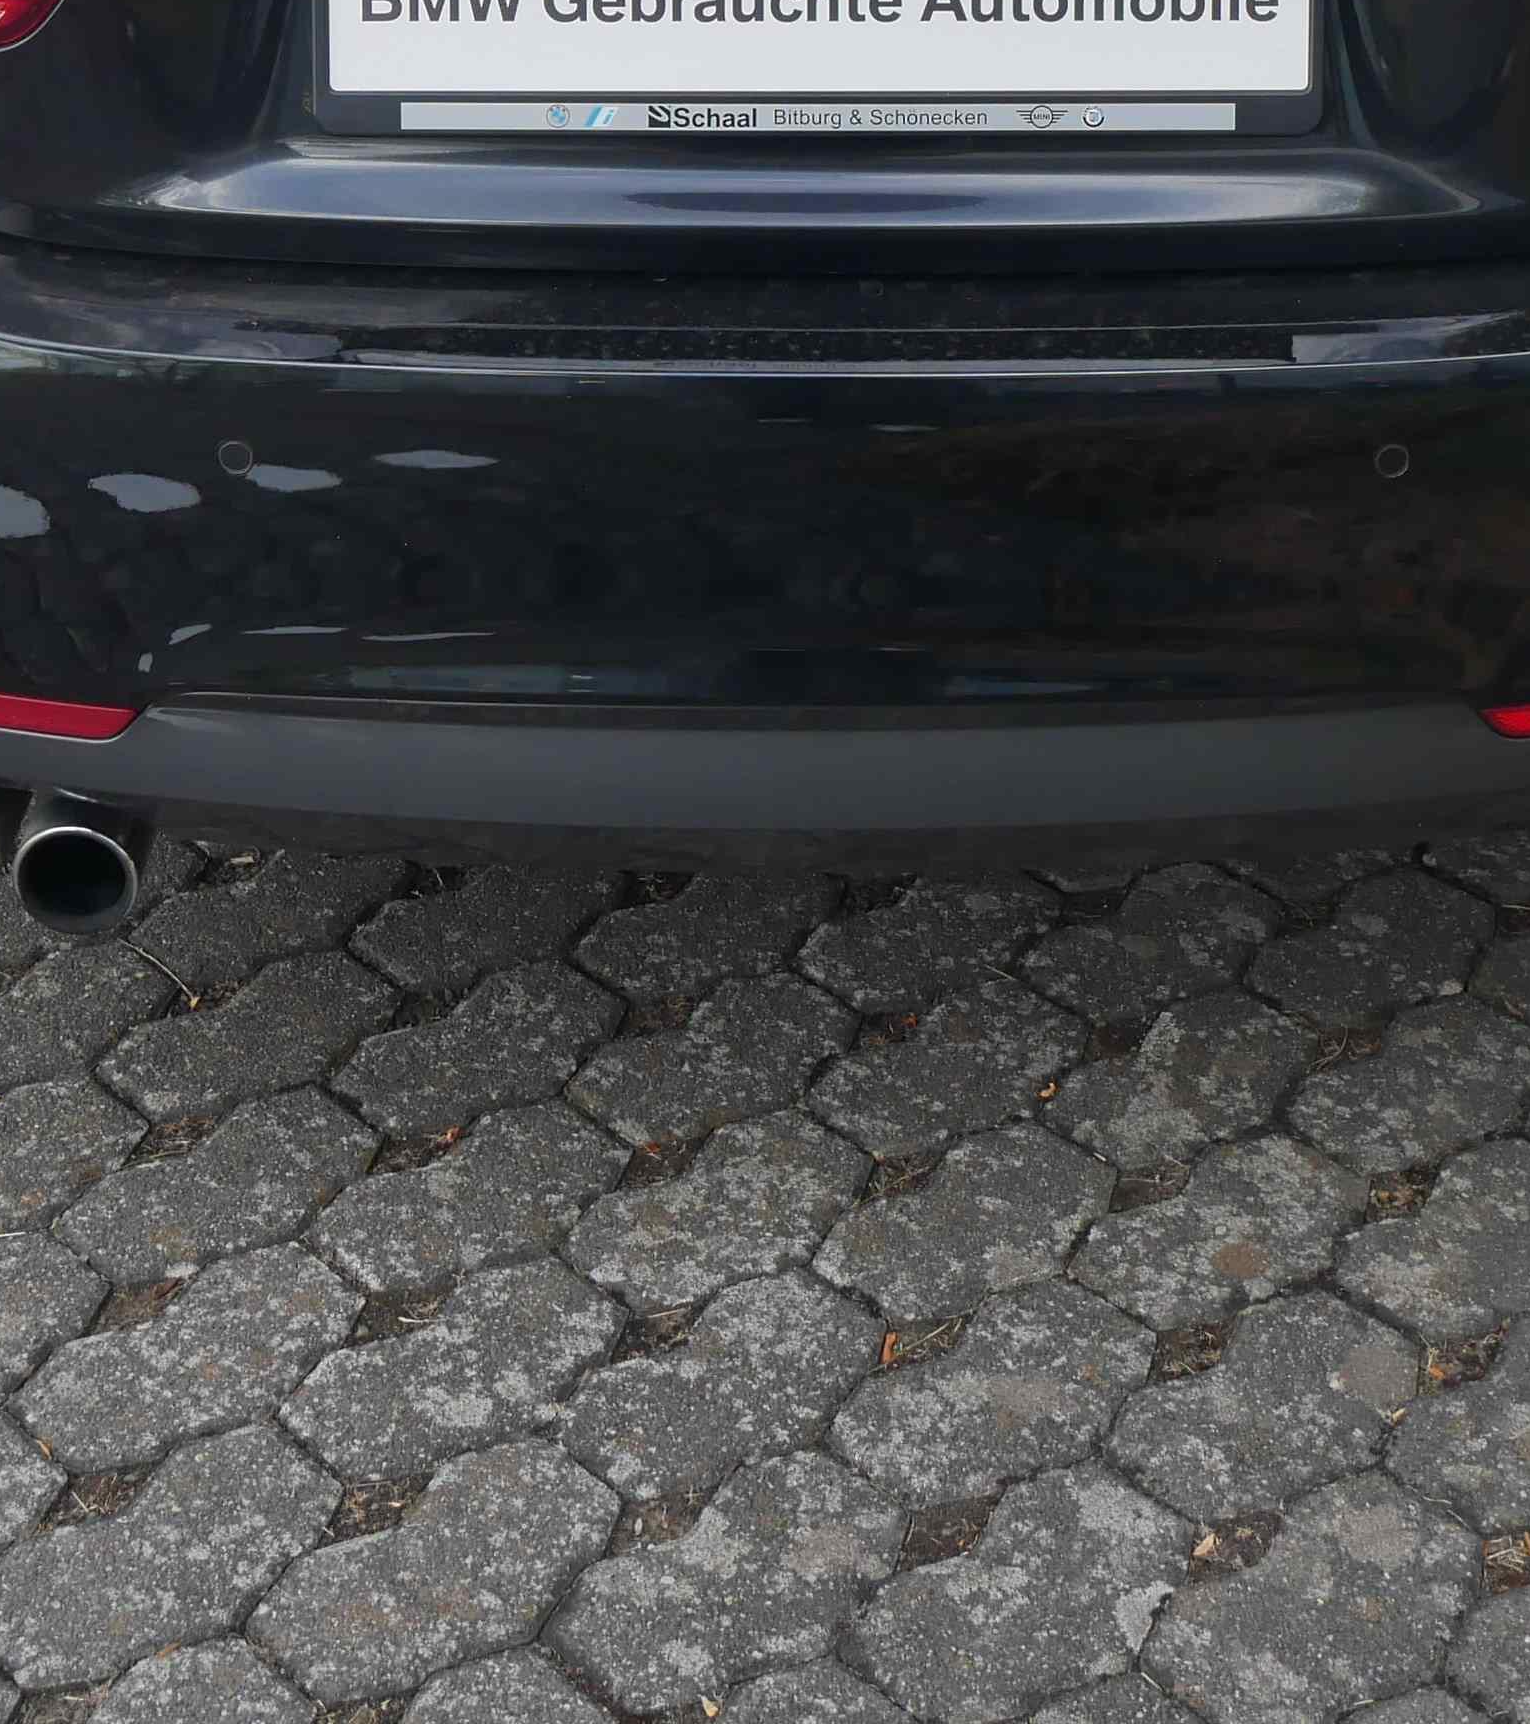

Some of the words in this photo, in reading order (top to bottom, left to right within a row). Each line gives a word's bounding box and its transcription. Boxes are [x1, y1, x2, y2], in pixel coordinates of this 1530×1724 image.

[672, 107, 758, 129] Schaal
[773, 108, 843, 129] Bitburg
[848, 108, 863, 126] &
[869, 108, 989, 126] Schönecken
